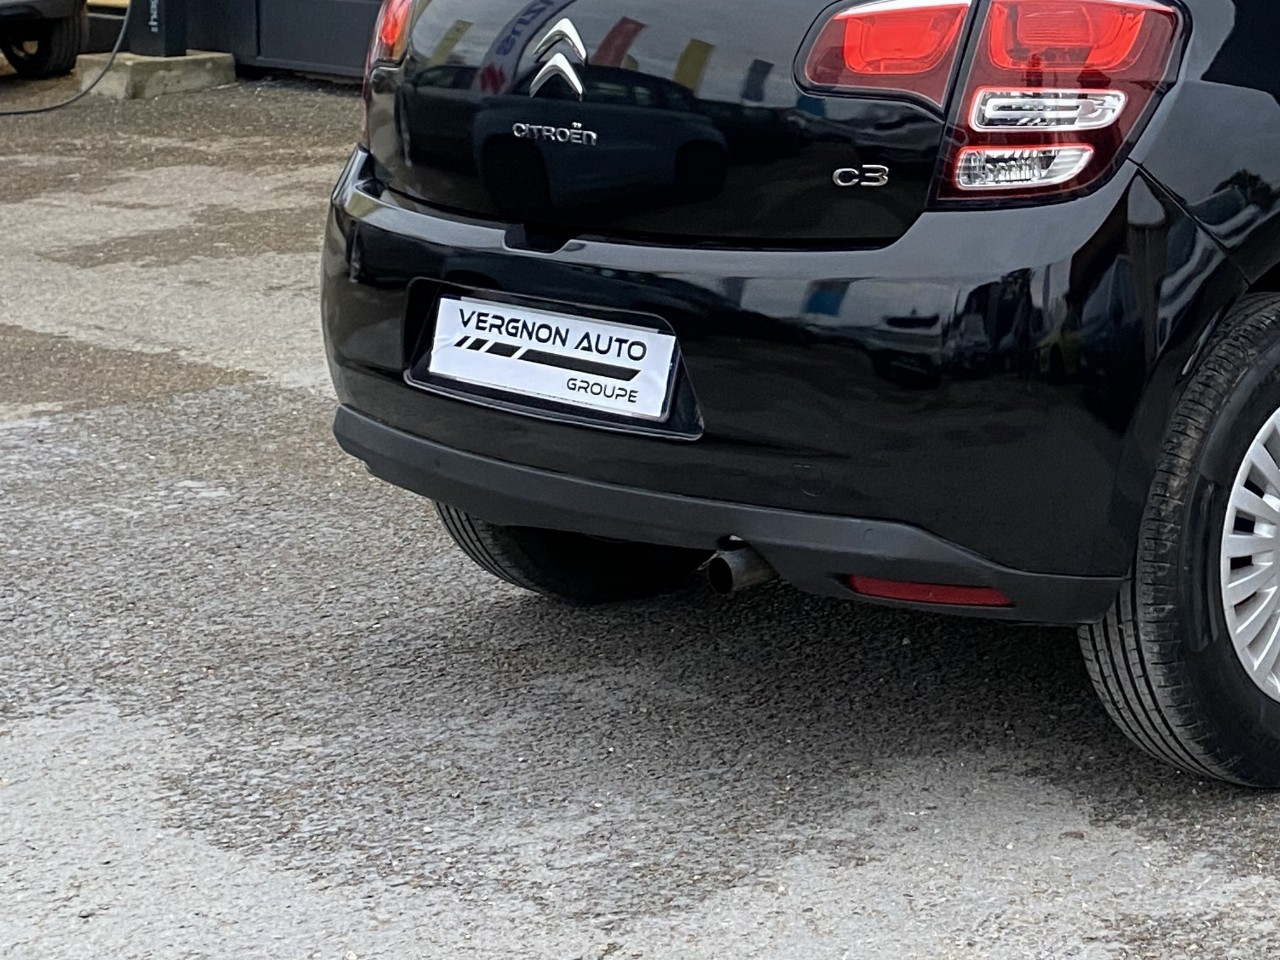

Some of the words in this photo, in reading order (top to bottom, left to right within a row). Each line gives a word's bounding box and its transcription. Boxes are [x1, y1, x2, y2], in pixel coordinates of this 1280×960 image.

[832, 164, 890, 188] C3
[459, 308, 570, 348] VERGNON
[575, 331, 648, 362] AUTO
[566, 377, 639, 404] GROUPE
